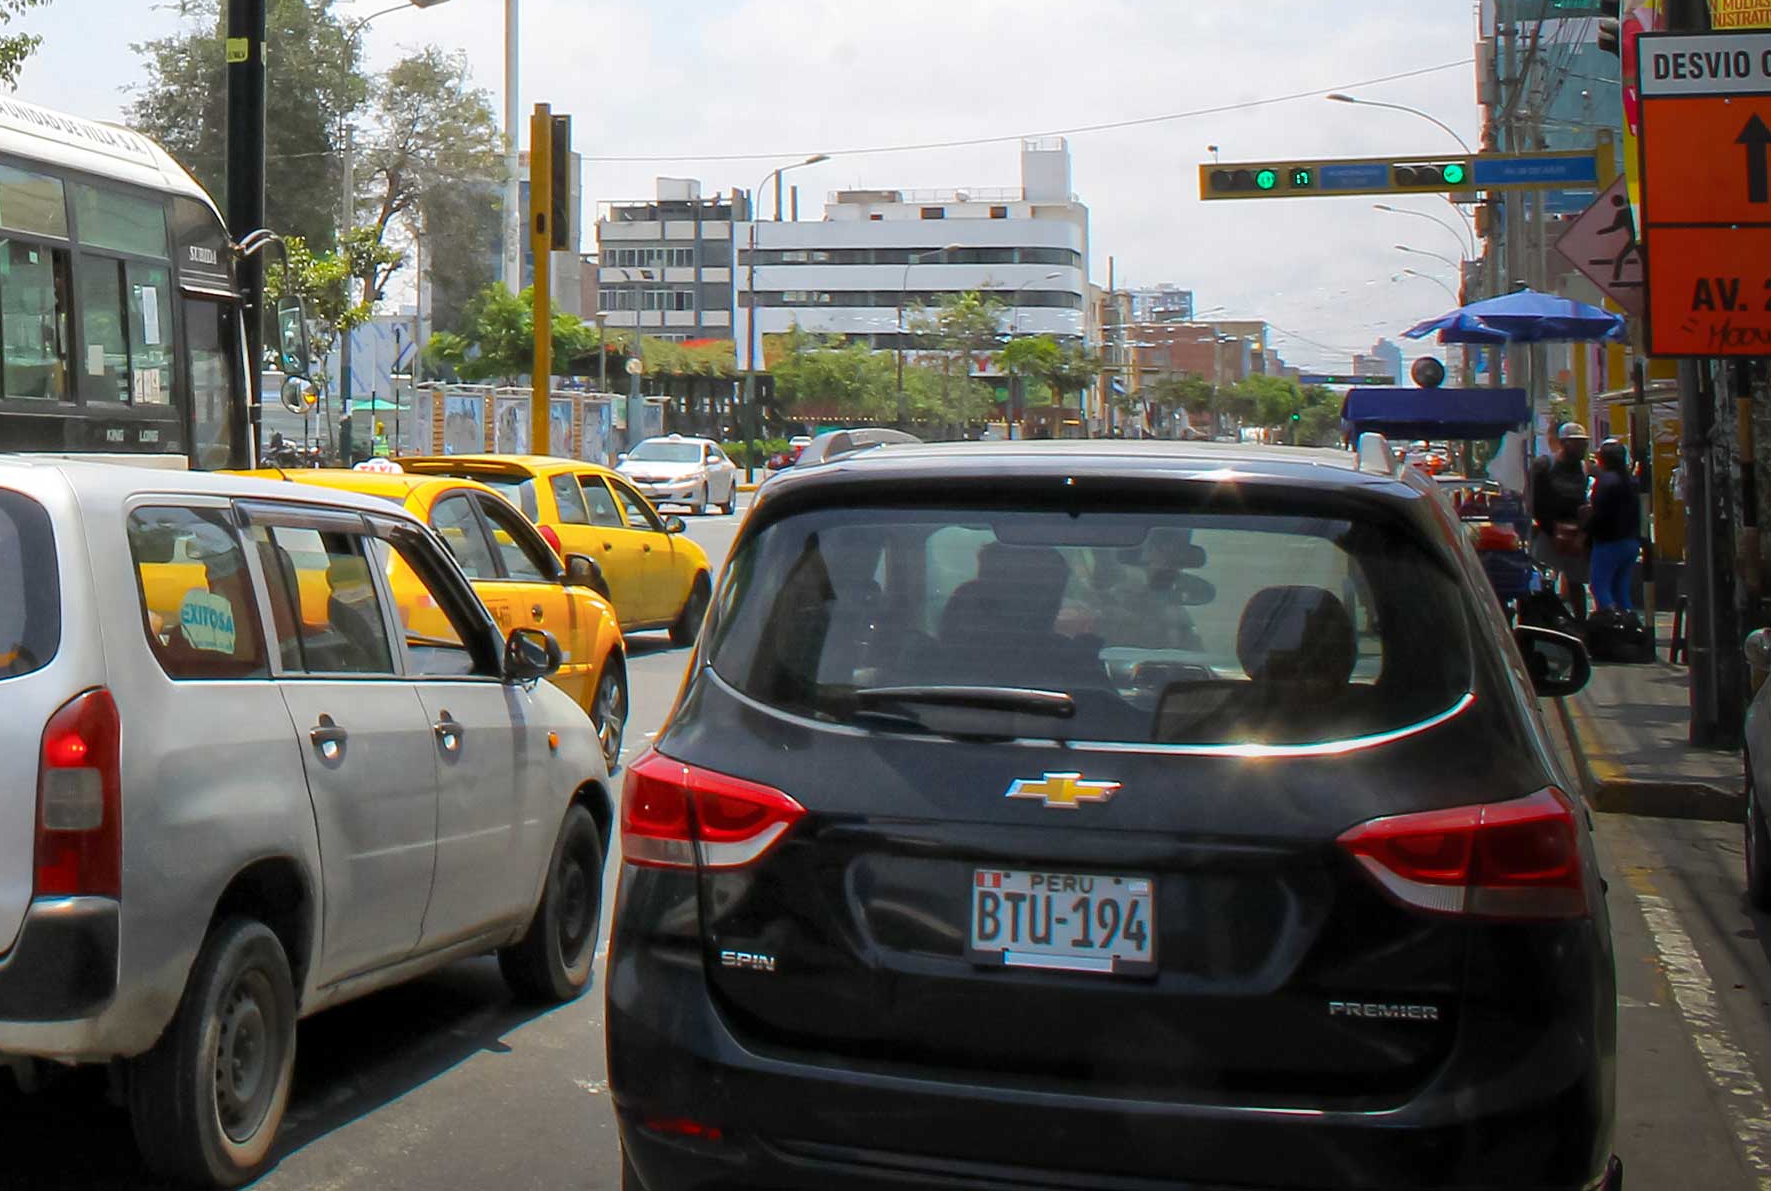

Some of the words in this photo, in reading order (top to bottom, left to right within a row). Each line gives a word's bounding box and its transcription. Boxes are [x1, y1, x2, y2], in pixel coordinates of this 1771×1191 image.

[1653, 50, 1750, 80] DESVIO
[5, 101, 62, 131] UNIDAD
[78, 122, 119, 147] VILLA
[1692, 277, 1748, 312] AV.
[1030, 874, 1094, 894] PERU
[978, 890, 1148, 951] BTU-194
[721, 950, 775, 971] SPIN
[1329, 1001, 1439, 1020] PREMIER
